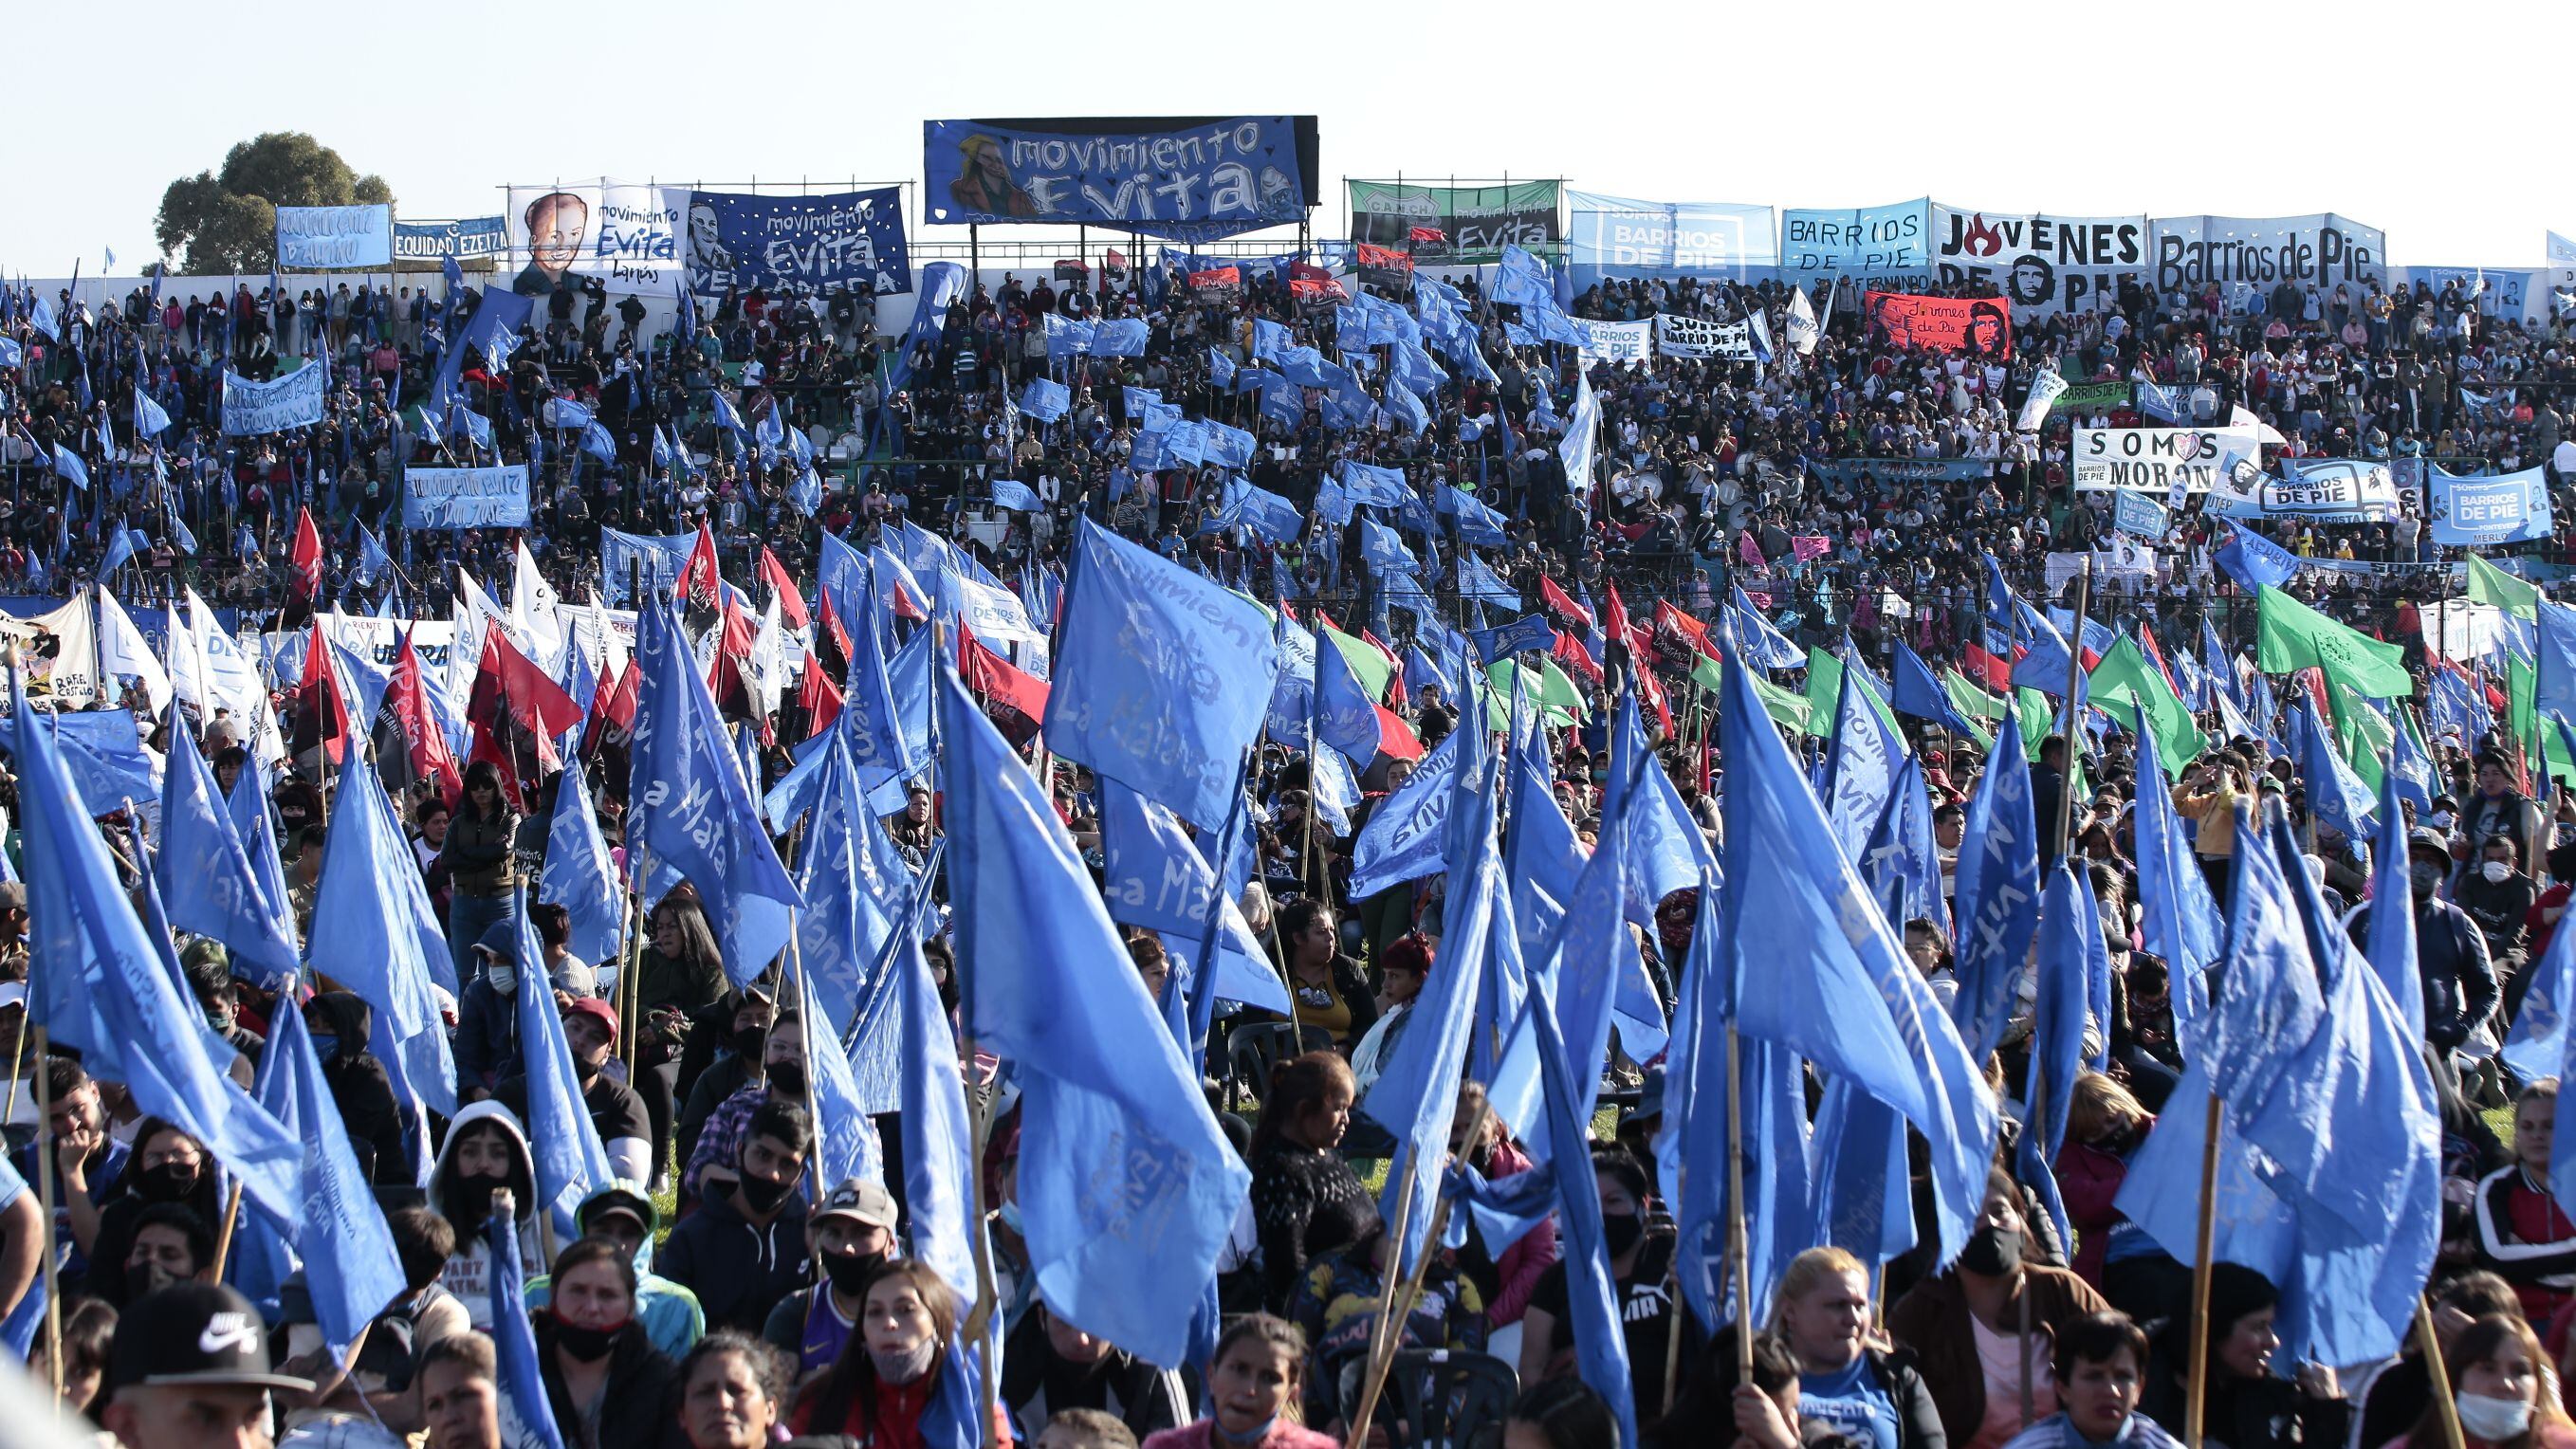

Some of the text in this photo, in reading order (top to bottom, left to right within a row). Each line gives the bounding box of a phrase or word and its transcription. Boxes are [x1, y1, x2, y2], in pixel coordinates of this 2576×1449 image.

[1615, 225, 1726, 248] BARRIOS
[1791, 214, 1918, 247] BARRIOS
[395, 230, 509, 256] EQUIDAD EZEIZA
[597, 225, 676, 261] Evita
[1614, 245, 1728, 270] DE PIE
[1800, 246, 1912, 271] DE PIE
[2157, 227, 2373, 295] Barrios de Pie
[1591, 331, 1640, 342] ARRIOS
[1711, 332, 1731, 345] DE
[1610, 343, 1640, 358] PIE
[2061, 380, 2130, 401] BARRIOS DE PIE
[2078, 472, 2105, 481] DE PIE
[2207, 496, 2233, 511] UTEP
[2276, 486, 2346, 504] DE PIE
[2459, 492, 2518, 506] BARRIOS
[2122, 509, 2157, 528] DE PIE
[2460, 504, 2519, 521] DE PIE
[2474, 532, 2509, 543] MERLO
